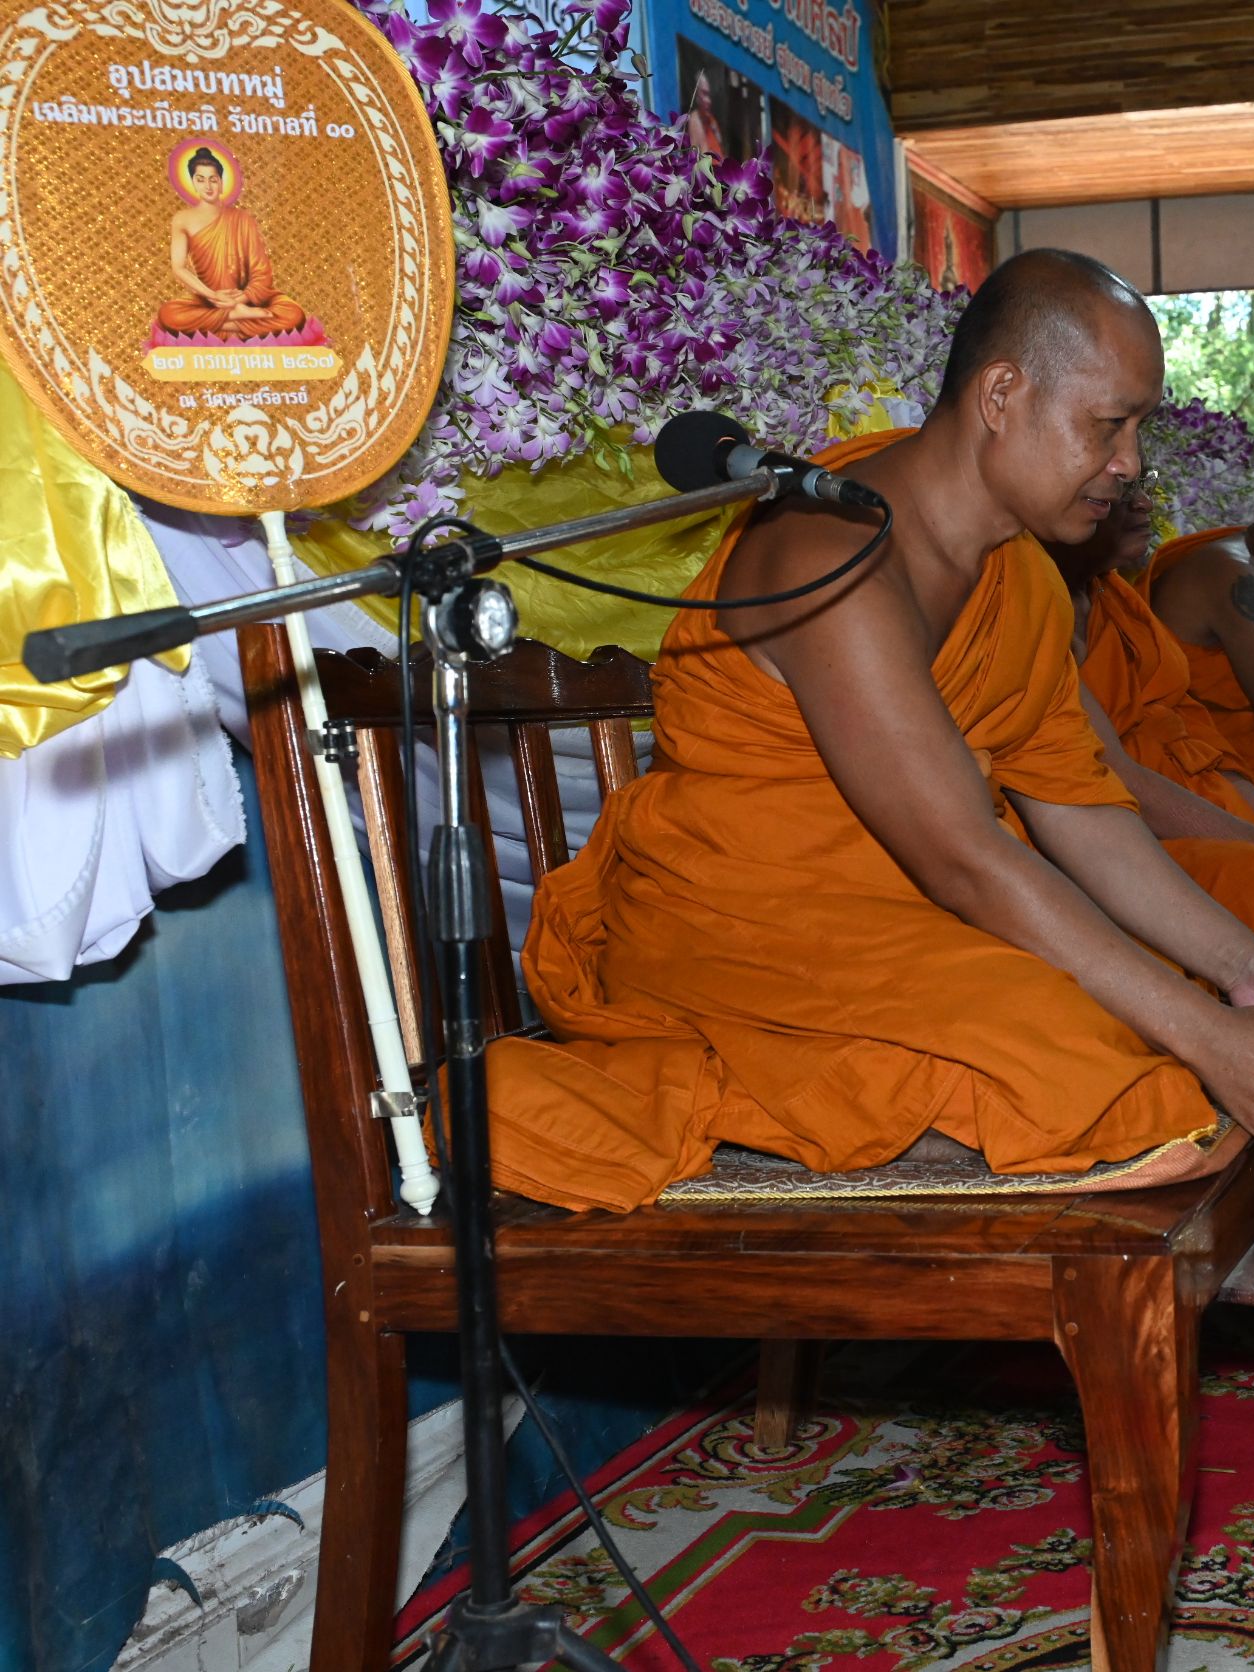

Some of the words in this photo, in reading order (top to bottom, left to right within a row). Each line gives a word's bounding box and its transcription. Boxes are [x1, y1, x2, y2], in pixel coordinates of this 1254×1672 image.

[108, 60, 286, 109] อุปสมบทหมู่
[32, 96, 218, 132] เฉลิมพระเกียรติ
[228, 104, 318, 137] รัชกาลที่
[325, 122, 355, 138] ๑๐
[152, 353, 184, 370] ๒๗
[193, 353, 275, 375] กรกฎาคม
[282, 352, 335, 369] ๒๕๖๗
[179, 394, 197, 408] ณ
[202, 385, 308, 407] วัดพระศรีอารย์
